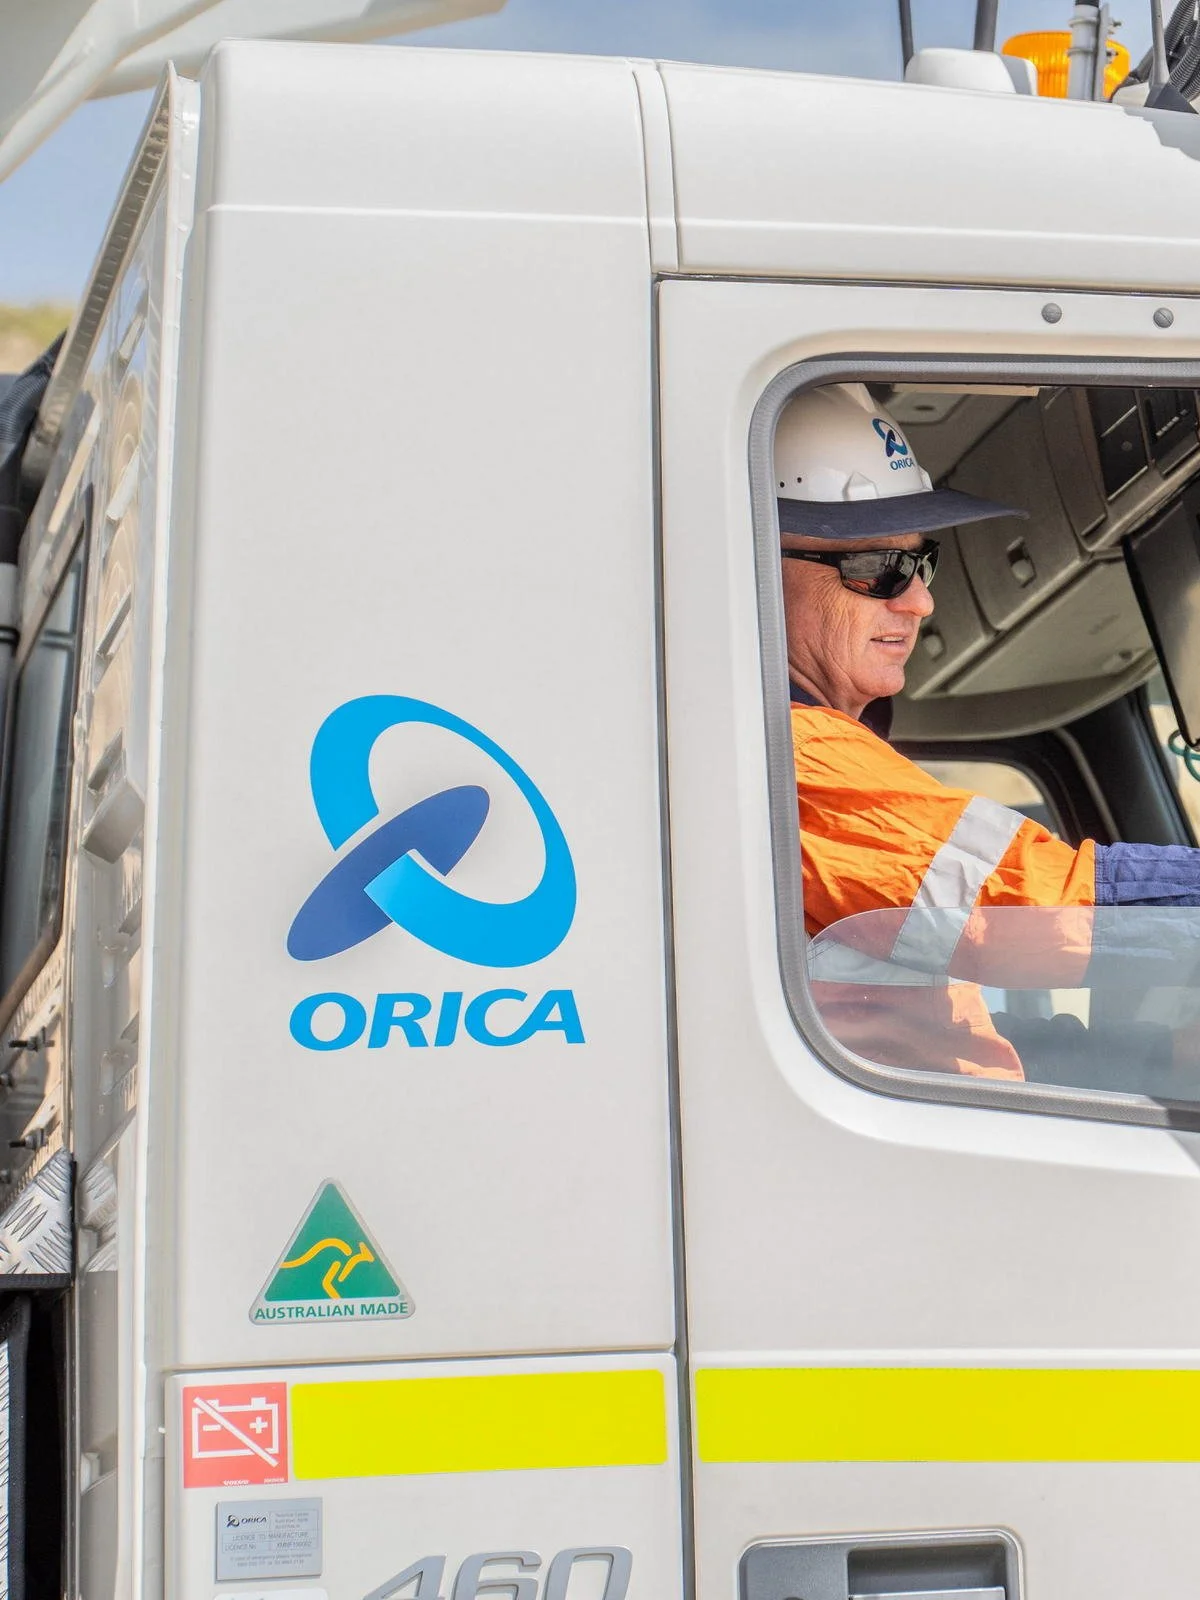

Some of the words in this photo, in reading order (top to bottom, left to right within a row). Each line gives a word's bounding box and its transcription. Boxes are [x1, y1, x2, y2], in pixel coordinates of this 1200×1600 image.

[289, 988, 586, 1051] ORICA
[254, 1304, 355, 1320] AUSTRALIAN
[360, 1302, 409, 1316] MADE
[363, 1546, 634, 1600] 460
